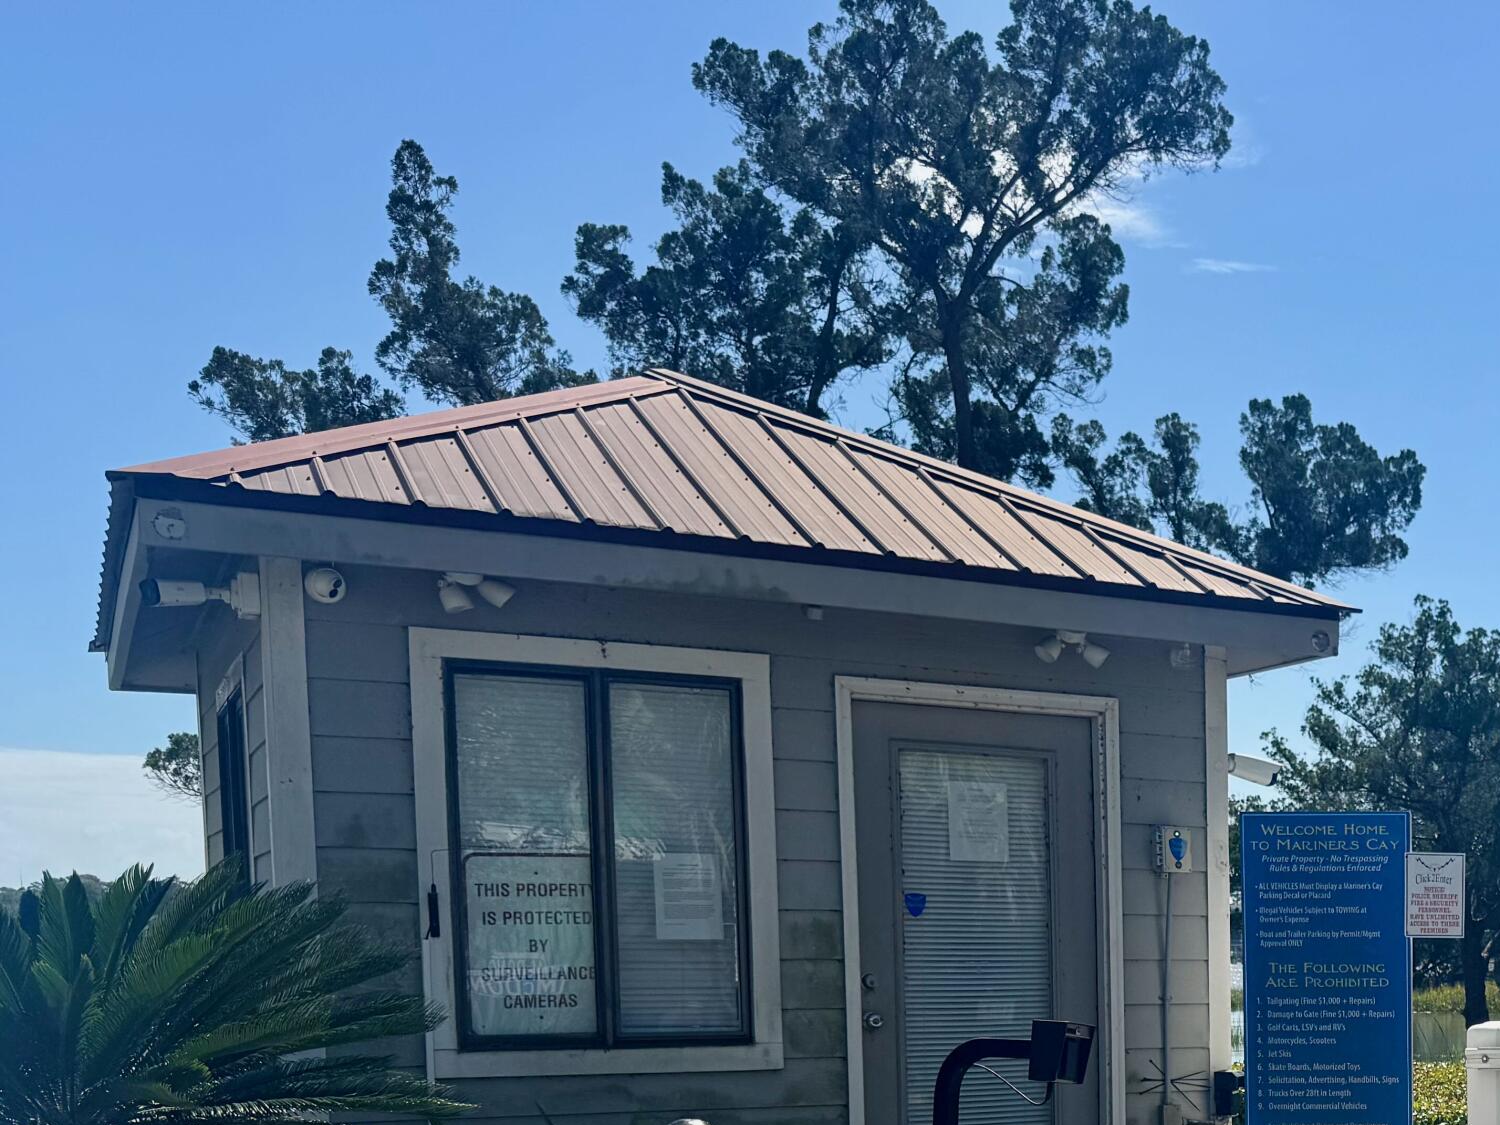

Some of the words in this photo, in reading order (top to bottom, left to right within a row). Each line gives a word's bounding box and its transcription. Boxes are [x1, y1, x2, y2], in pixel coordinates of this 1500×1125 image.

[1261, 823, 1337, 836] WELCOME
[1344, 824, 1389, 835] HOME
[1250, 841, 1269, 850] TO
[1277, 840, 1360, 850] MARINERS
[1366, 839, 1399, 850] CAY
[1262, 855, 1289, 863] Private
[1290, 856, 1324, 864] Property
[1343, 855, 1389, 864] Trespassing
[1269, 864, 1291, 872] Rules
[1292, 864, 1298, 872] &
[1299, 864, 1346, 873] Regulations
[1347, 864, 1381, 872] Enforced
[474, 883, 510, 897] THIS
[516, 883, 593, 897] PROPERTY
[1316, 883, 1338, 892] Display
[1372, 883, 1382, 891] Cay
[1259, 892, 1283, 900] Parking
[1259, 907, 1278, 915] Illegal
[1305, 907, 1327, 915] Subject
[482, 911, 496, 925] IS
[503, 911, 592, 925] PROTECTED
[1285, 916, 1309, 924] Expense
[1308, 931, 1331, 939] Parking
[1331, 931, 1339, 939] by
[529, 939, 548, 953] BY
[1260, 940, 1287, 948] Approval
[1268, 962, 1297, 973] THE
[1303, 962, 1385, 973] FOLLOWING
[1265, 978, 1299, 988] ARE
[1305, 977, 1389, 988] PROHIBITED
[504, 994, 578, 1009] CAMERAS
[1267, 998, 1299, 1006] Tailgating
[1301, 997, 1317, 1005] (Fine
[1349, 997, 1375, 1006] Repairs)
[1267, 1011, 1294, 1019] Damage
[1320, 1010, 1336, 1018] (Fine
[1369, 1010, 1395, 1019] Repairs)
[1282, 1024, 1300, 1032] Carts,
[1268, 1037, 1308, 1046] Motorcycles,
[1268, 1050, 1278, 1058] Jet
[1287, 1063, 1311, 1071] Boards,
[1346, 1063, 1360, 1071] Toys
[1268, 1077, 1307, 1085] Solicitation,
[1308, 1076, 1347, 1085] Advertising,
[1349, 1076, 1380, 1084] Handbills,
[1382, 1076, 1399, 1084] Signs
[1328, 1090, 1351, 1098] Length
[1269, 1103, 1301, 1111] Overnight
